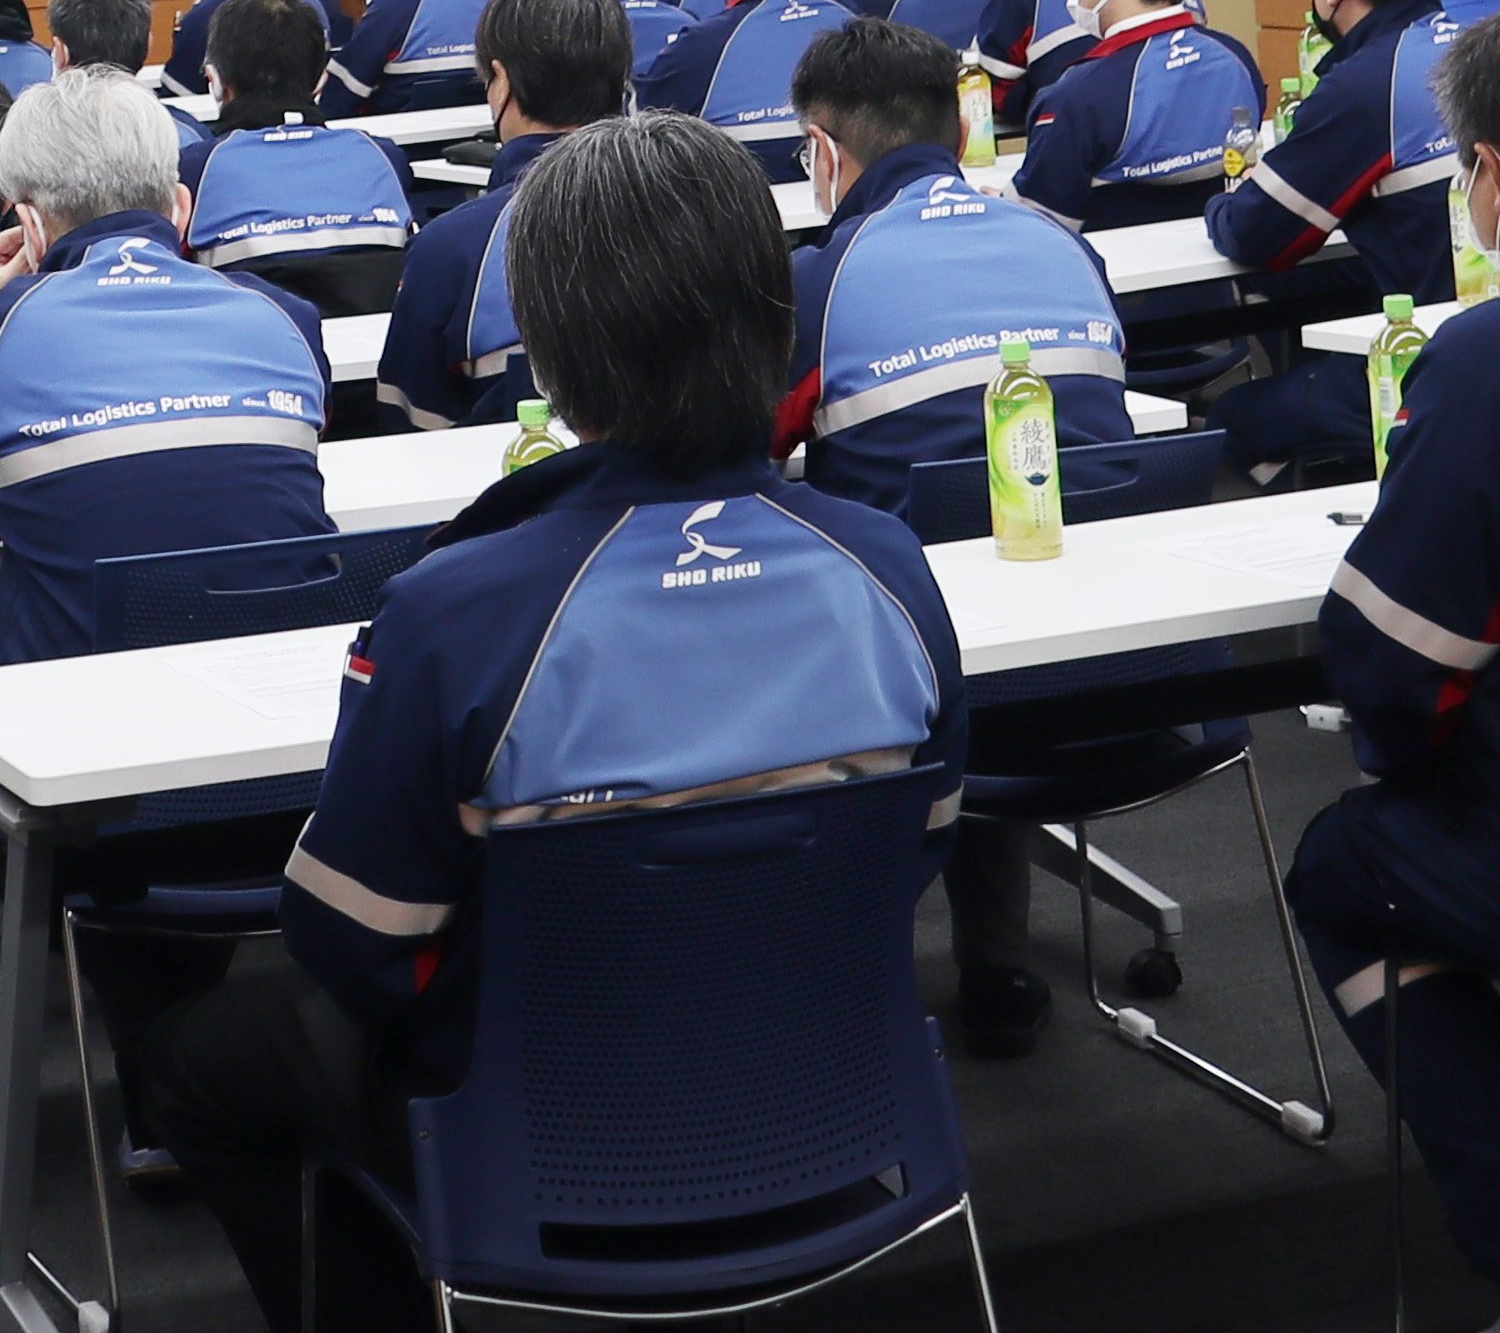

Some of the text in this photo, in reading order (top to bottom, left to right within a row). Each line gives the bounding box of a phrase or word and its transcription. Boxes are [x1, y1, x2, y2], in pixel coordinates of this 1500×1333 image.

[767, 106, 793, 120] Logis
[1122, 143, 1223, 180] Total Logistics Partne
[248, 217, 303, 236] Logistics
[306, 211, 352, 229] Partner
[921, 202, 985, 220] SHO RIKU
[98, 276, 171, 286] SHO RIKU
[869, 355, 914, 380] Total
[917, 336, 998, 367] Logistics
[1001, 325, 1060, 347] Partner
[20, 414, 67, 439] Total
[71, 398, 156, 427] Logistics
[160, 390, 231, 414] Partner
[267, 388, 303, 417] 1954
[1020, 419, 1047, 471] 綾鷹
[662, 560, 761, 591] SHO RIKU
